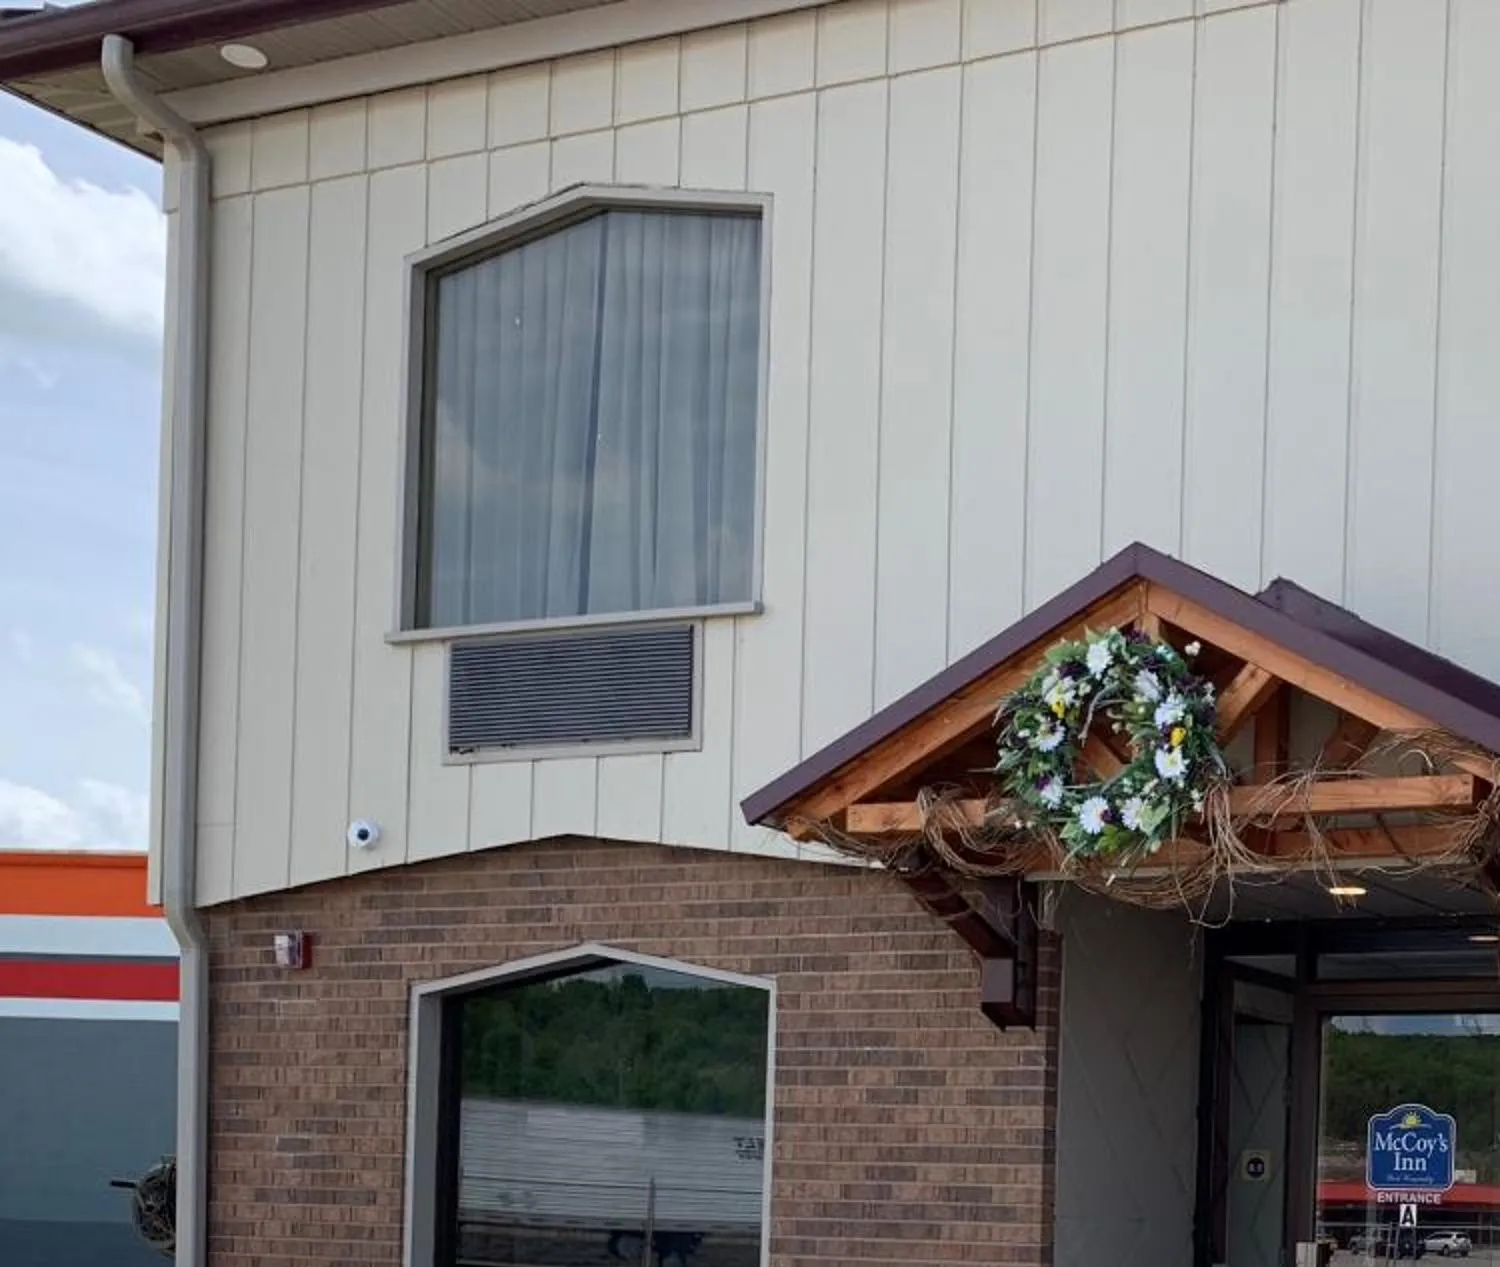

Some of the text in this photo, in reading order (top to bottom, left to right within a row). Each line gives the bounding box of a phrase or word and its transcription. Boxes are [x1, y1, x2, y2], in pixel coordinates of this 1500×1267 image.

[1374, 1131, 1449, 1158] McCoy's
[1393, 1152, 1428, 1171] Inn
[1377, 1191, 1441, 1204] ENTRANCE
